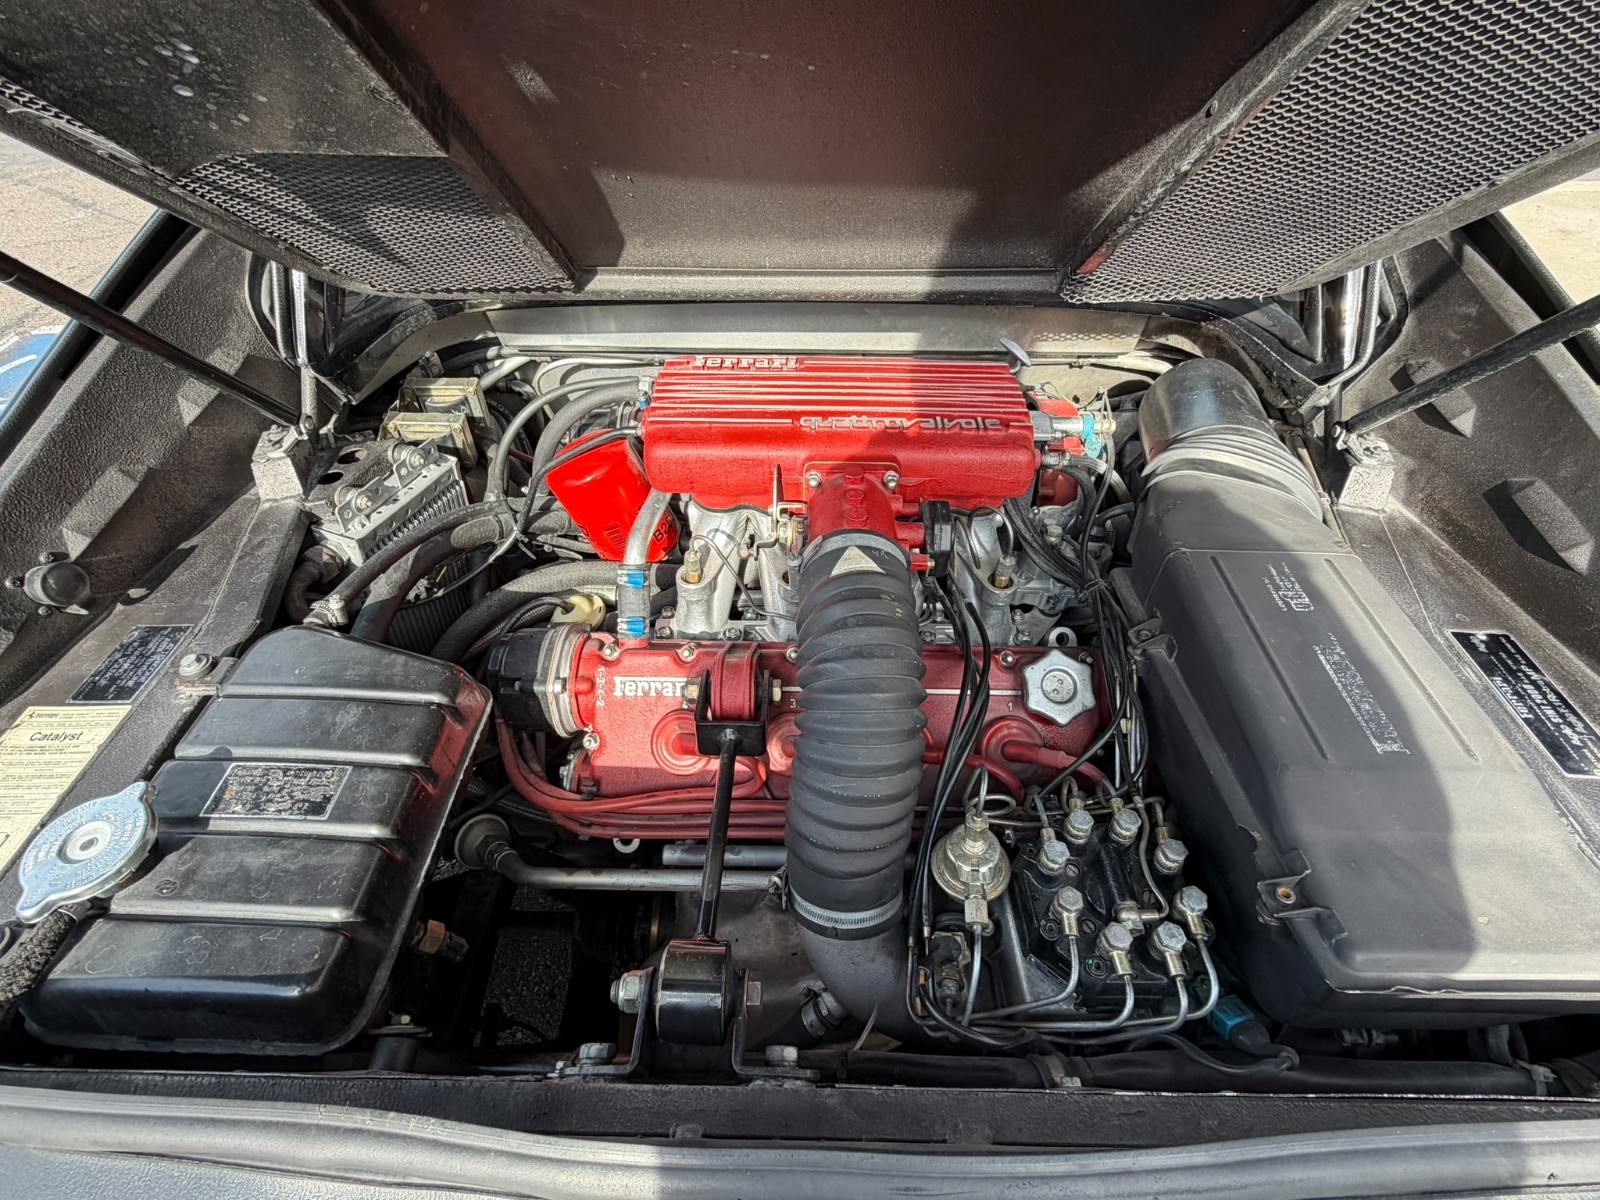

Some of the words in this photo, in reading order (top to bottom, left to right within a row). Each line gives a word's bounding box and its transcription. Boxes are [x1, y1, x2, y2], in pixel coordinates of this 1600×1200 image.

[694, 356, 798, 369] Ferrari
[799, 415, 1003, 432] quattrovalvole
[613, 676, 687, 697] Ferrar
[1521, 684, 1548, 704] 2000
[1007, 702, 1013, 711] 1
[1489, 677, 1534, 719] Ferrari
[1540, 705, 1563, 723] SINT
[1565, 713, 1588, 734] Agip
[29, 731, 84, 742] Catalyst
[1560, 724, 1584, 746] Agip
